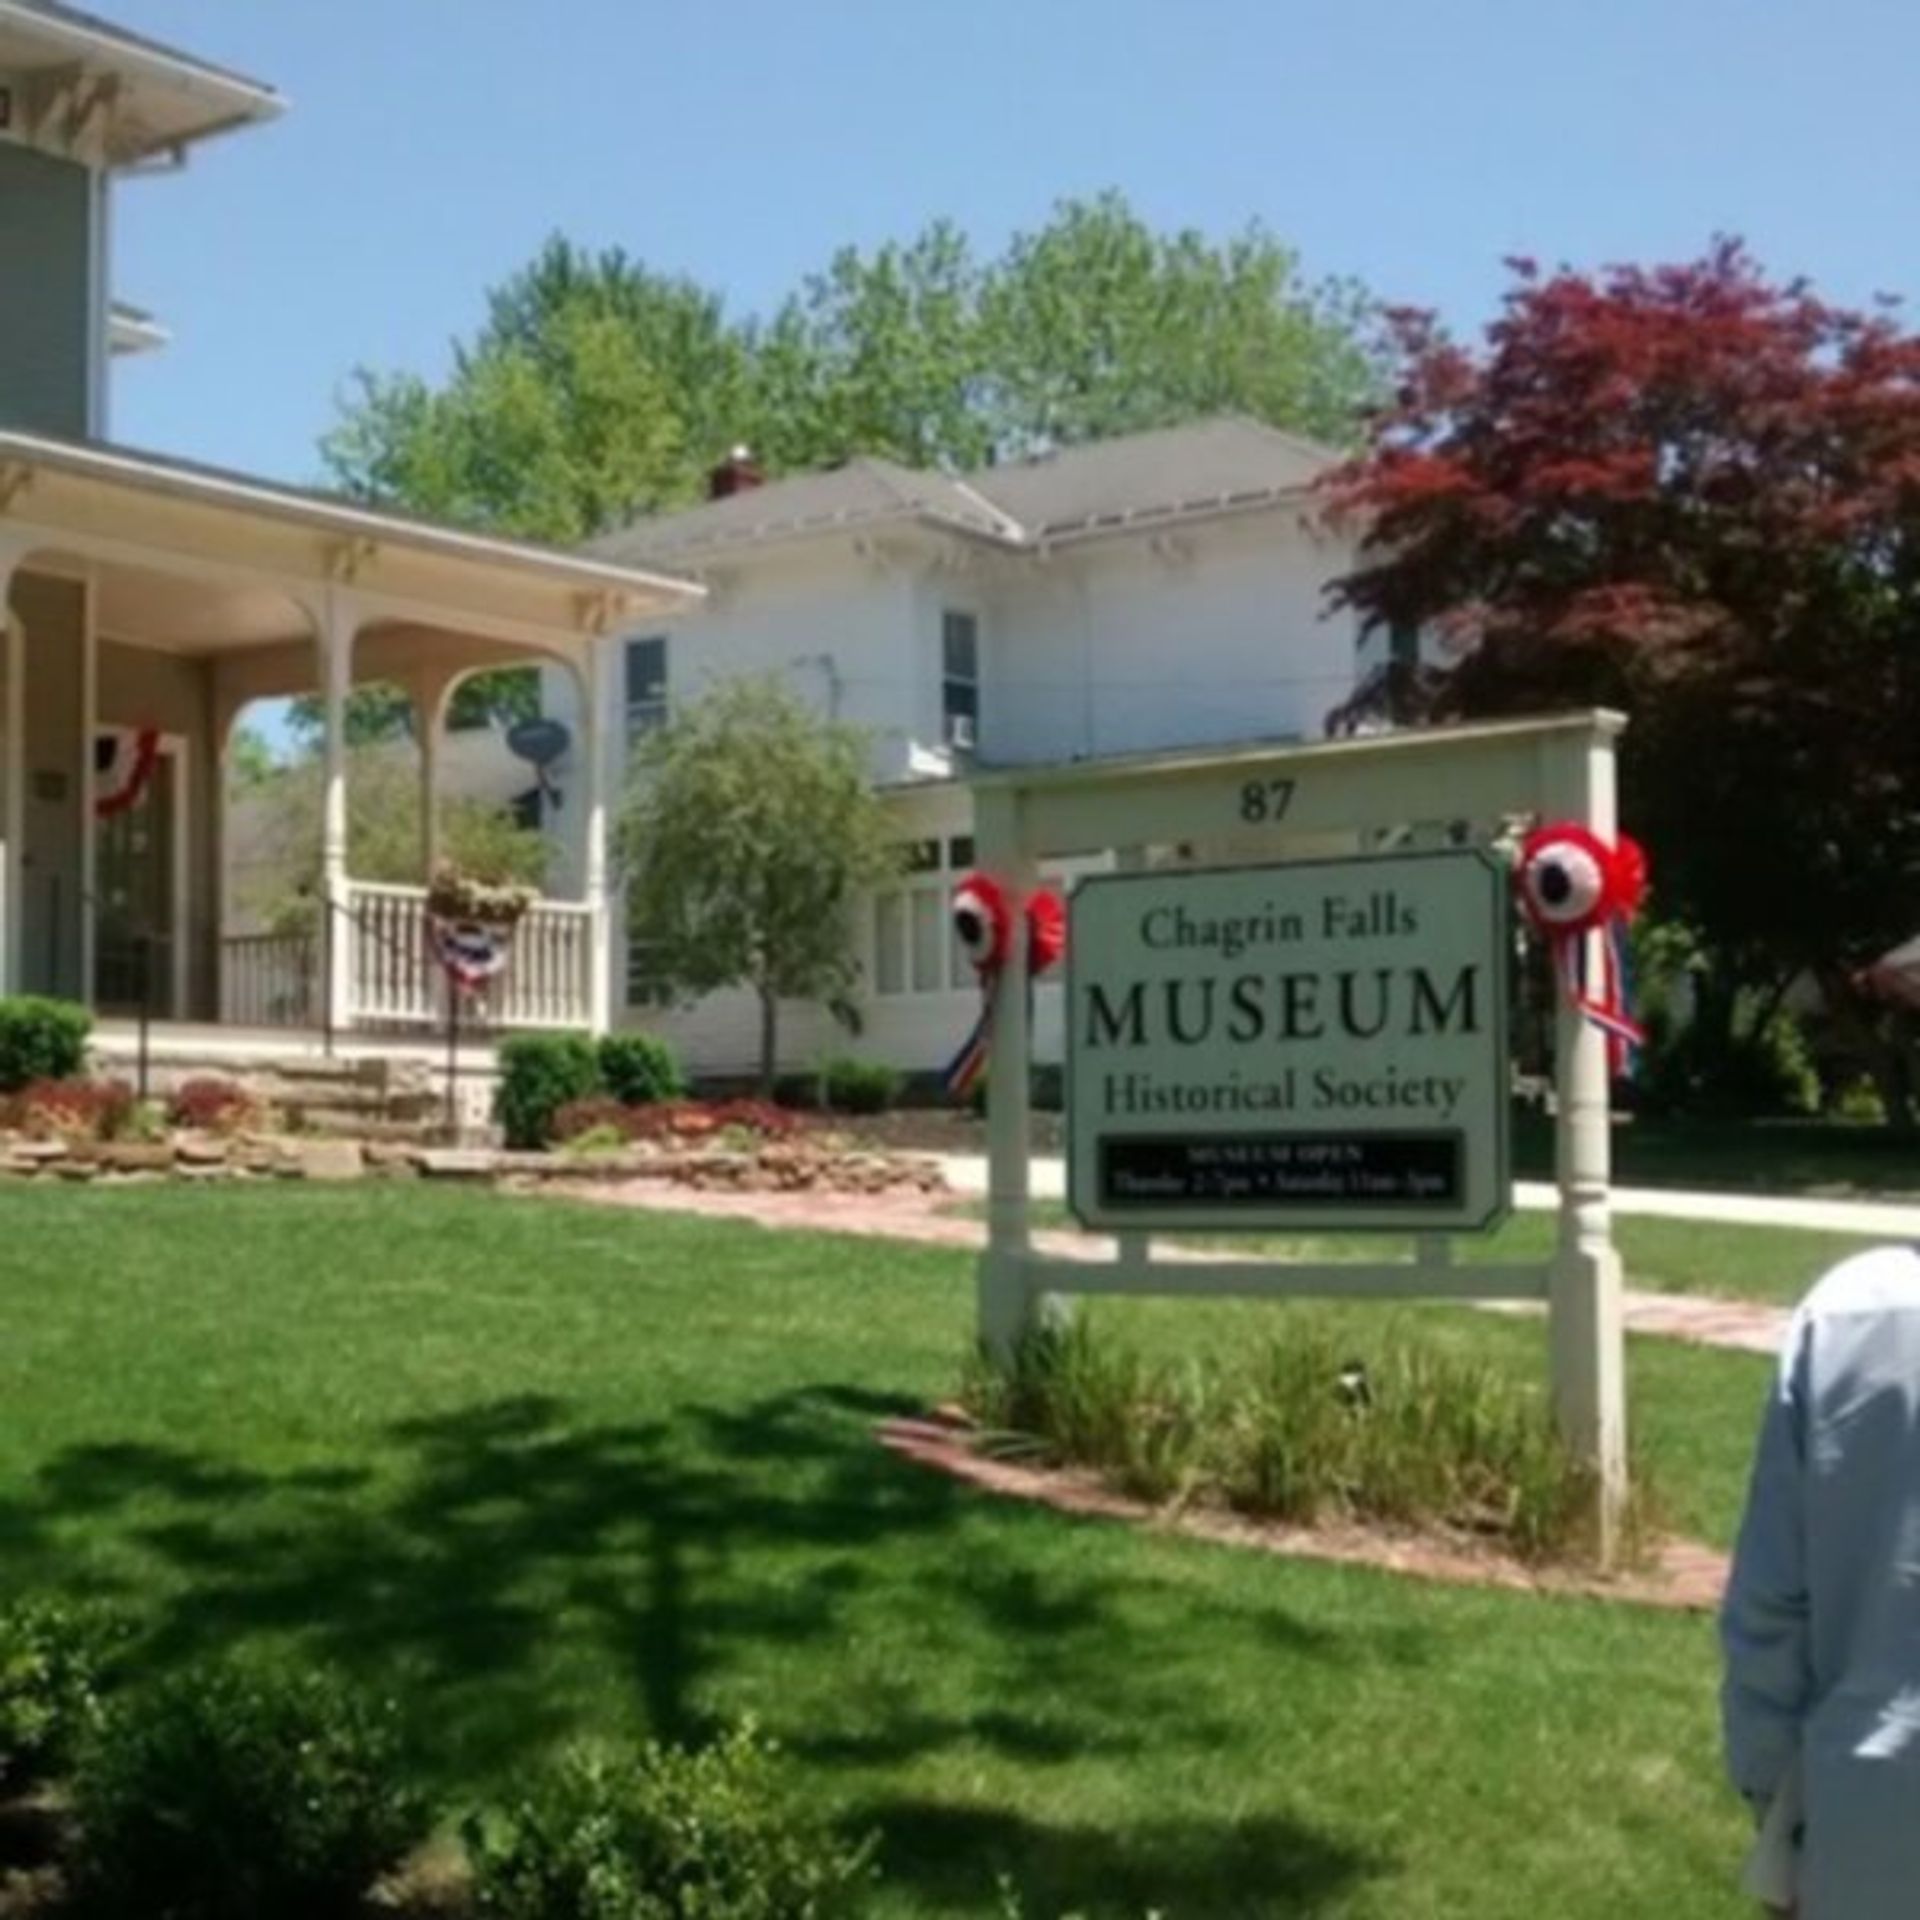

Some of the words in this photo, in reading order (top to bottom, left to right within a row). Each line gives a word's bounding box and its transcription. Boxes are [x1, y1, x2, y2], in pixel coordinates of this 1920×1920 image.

[1240, 779, 1295, 823] 87
[1140, 903, 1304, 958] Chagrin
[1322, 892, 1419, 940] Falls
[1085, 965, 1480, 1046] MUSEUM
[1104, 1068, 1296, 1114] Historical
[1312, 1064, 1464, 1118] Society
